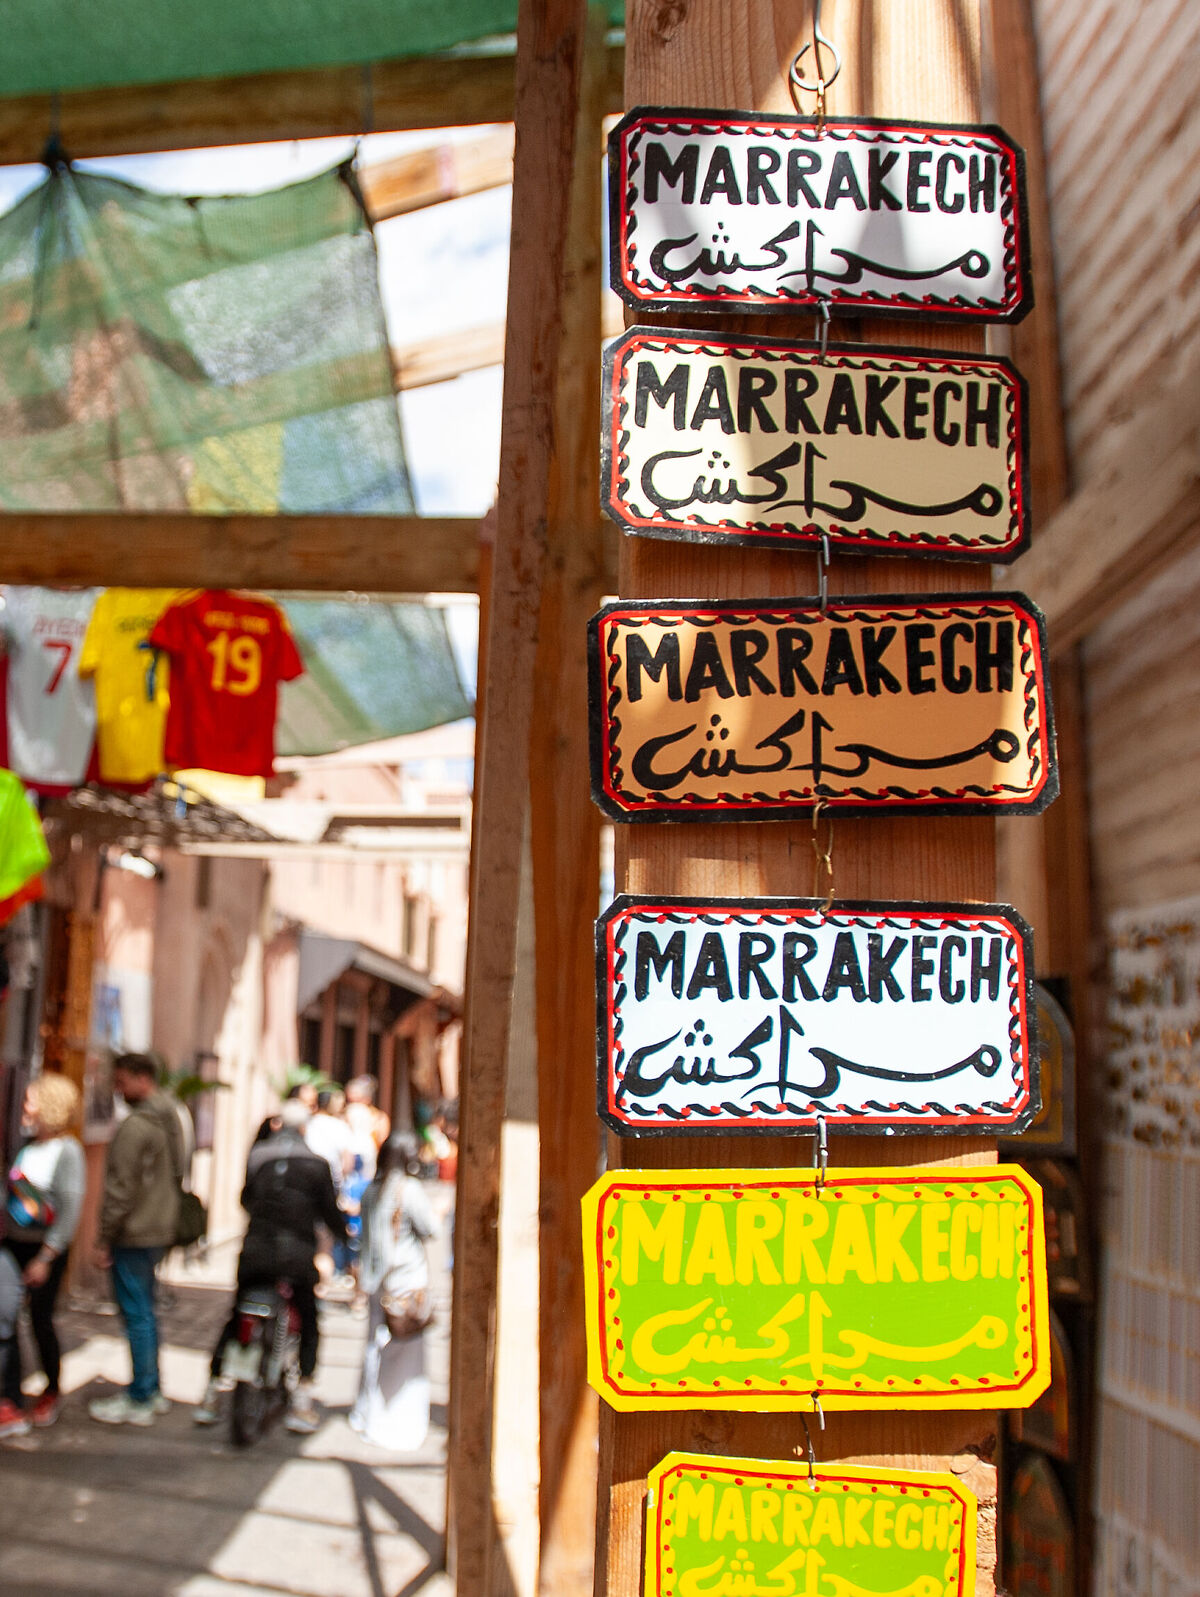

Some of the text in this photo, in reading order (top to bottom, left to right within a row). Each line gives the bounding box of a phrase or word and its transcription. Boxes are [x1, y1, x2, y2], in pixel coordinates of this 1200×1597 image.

[644, 143, 996, 213] MARRAKECH
[650, 219, 990, 288] مراكش
[634, 361, 1000, 449] MARRAKECH
[641, 441, 1003, 521] مراكش
[43, 637, 72, 695] 7
[206, 631, 262, 696] 19
[625, 621, 1014, 701] MARRAKECH
[633, 709, 1020, 790] مراكش
[634, 931, 1000, 1003] MARRAKECH
[625, 1006, 1001, 1102] مراكش
[620, 1201, 1015, 1285] MARRAKECH
[631, 1291, 1008, 1376] مراكش
[673, 1481, 948, 1551] MARRAKECH
